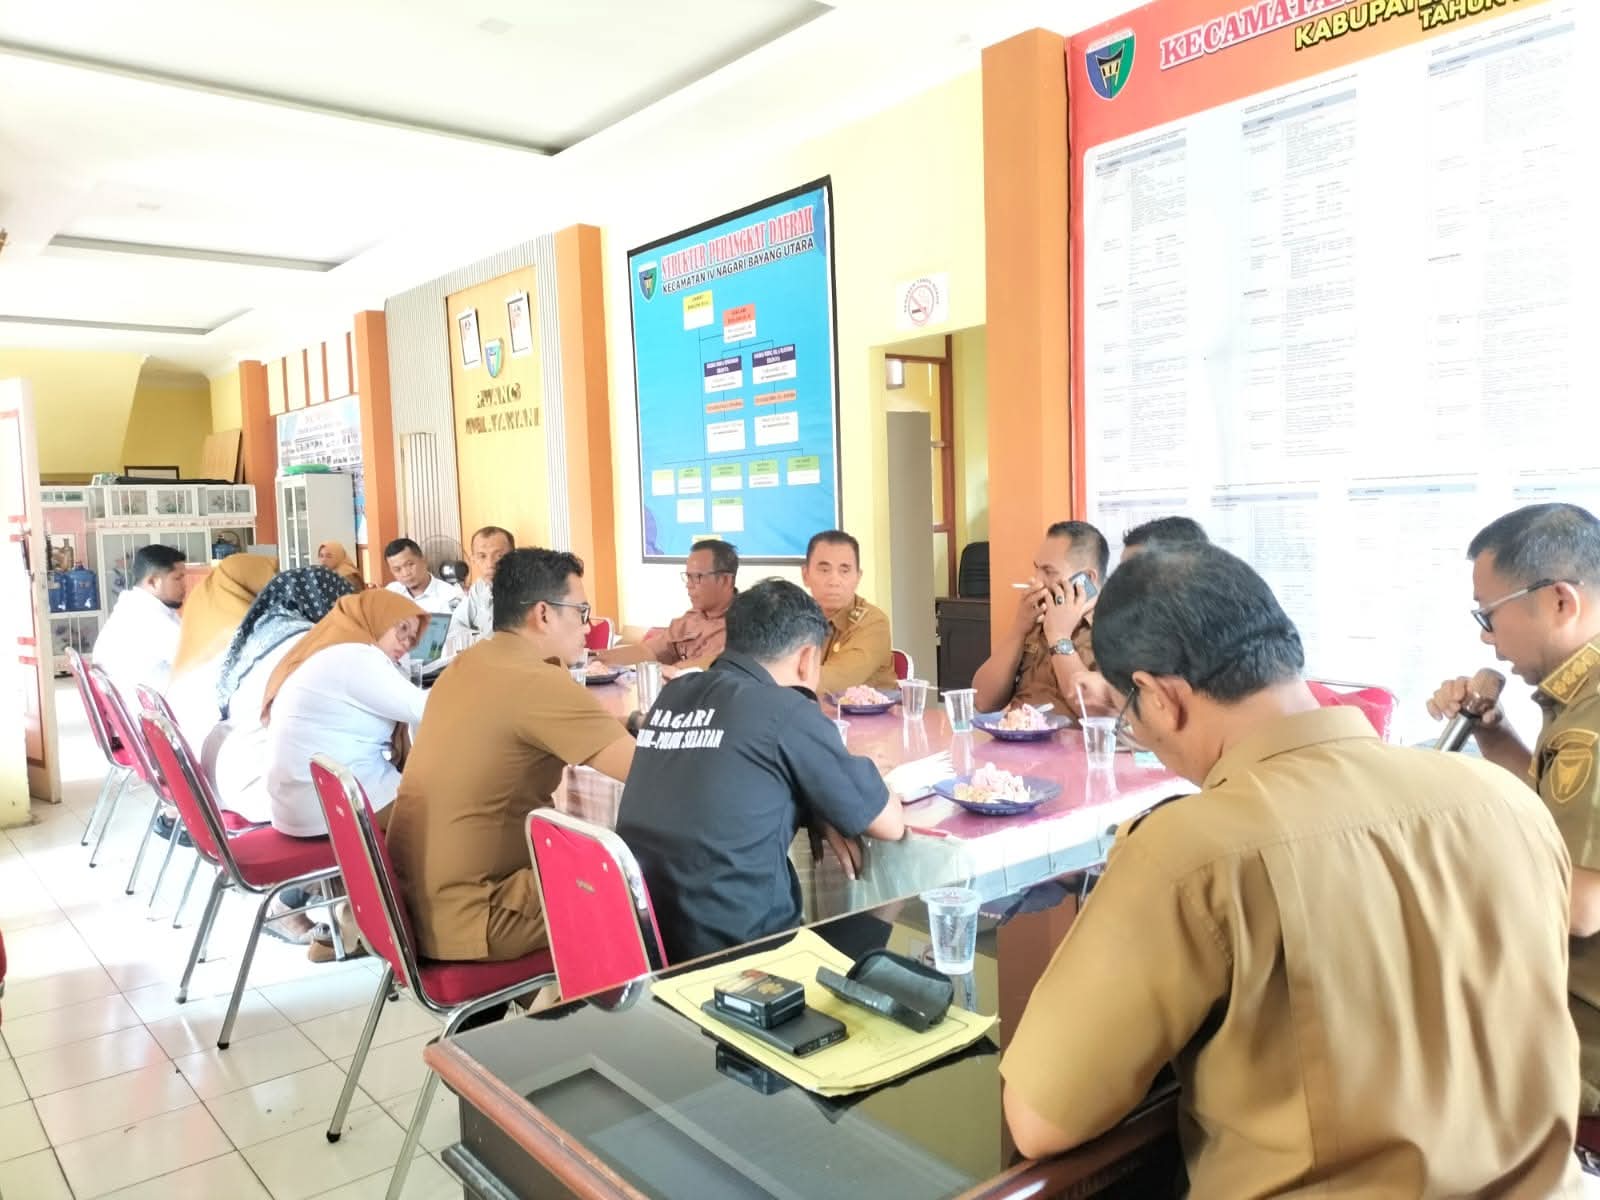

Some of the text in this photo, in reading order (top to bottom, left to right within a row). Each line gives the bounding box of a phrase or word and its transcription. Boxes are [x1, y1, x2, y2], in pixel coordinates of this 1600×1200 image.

[662, 206, 814, 280] STRUKTUR PERANGKAT DAERAH
[663, 237, 814, 294] KECAMATAN IV NAGARI BAYANG UTARA
[650, 708, 716, 728] NAGARI
